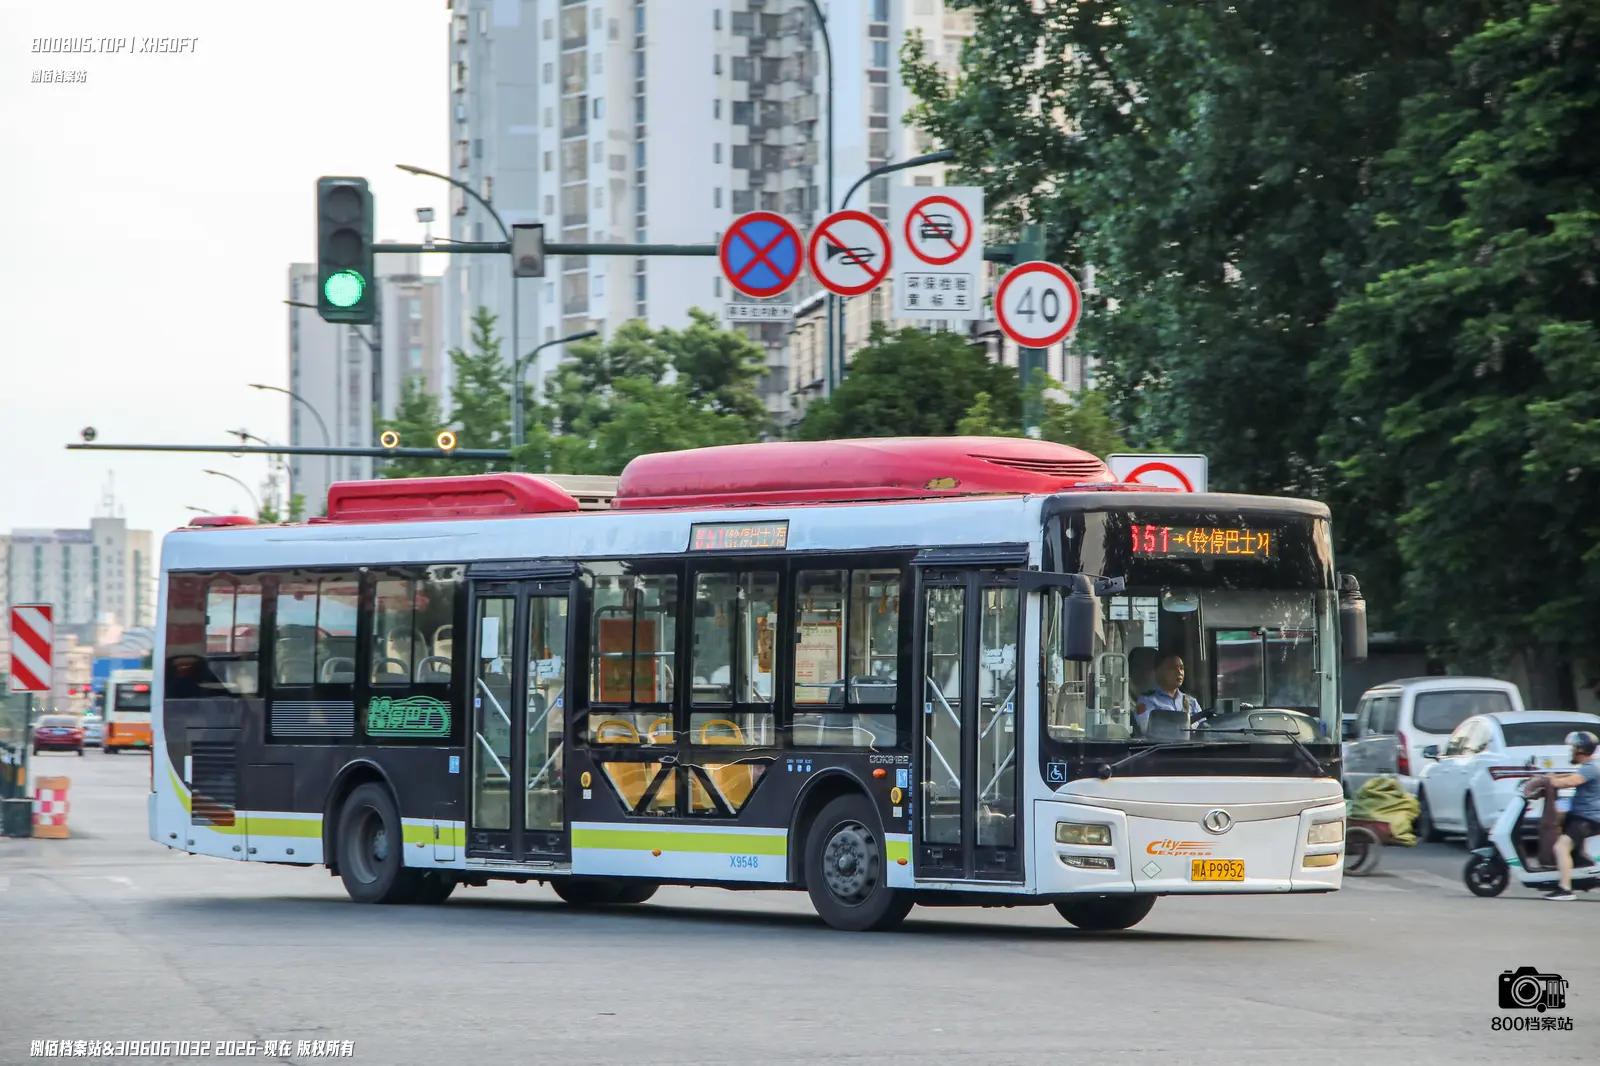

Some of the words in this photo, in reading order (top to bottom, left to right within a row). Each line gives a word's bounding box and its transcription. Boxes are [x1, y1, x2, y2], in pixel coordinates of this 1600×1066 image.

[1015, 286, 1060, 324] 40
[1146, 840, 1180, 855] City
[729, 855, 758, 868] X9548
